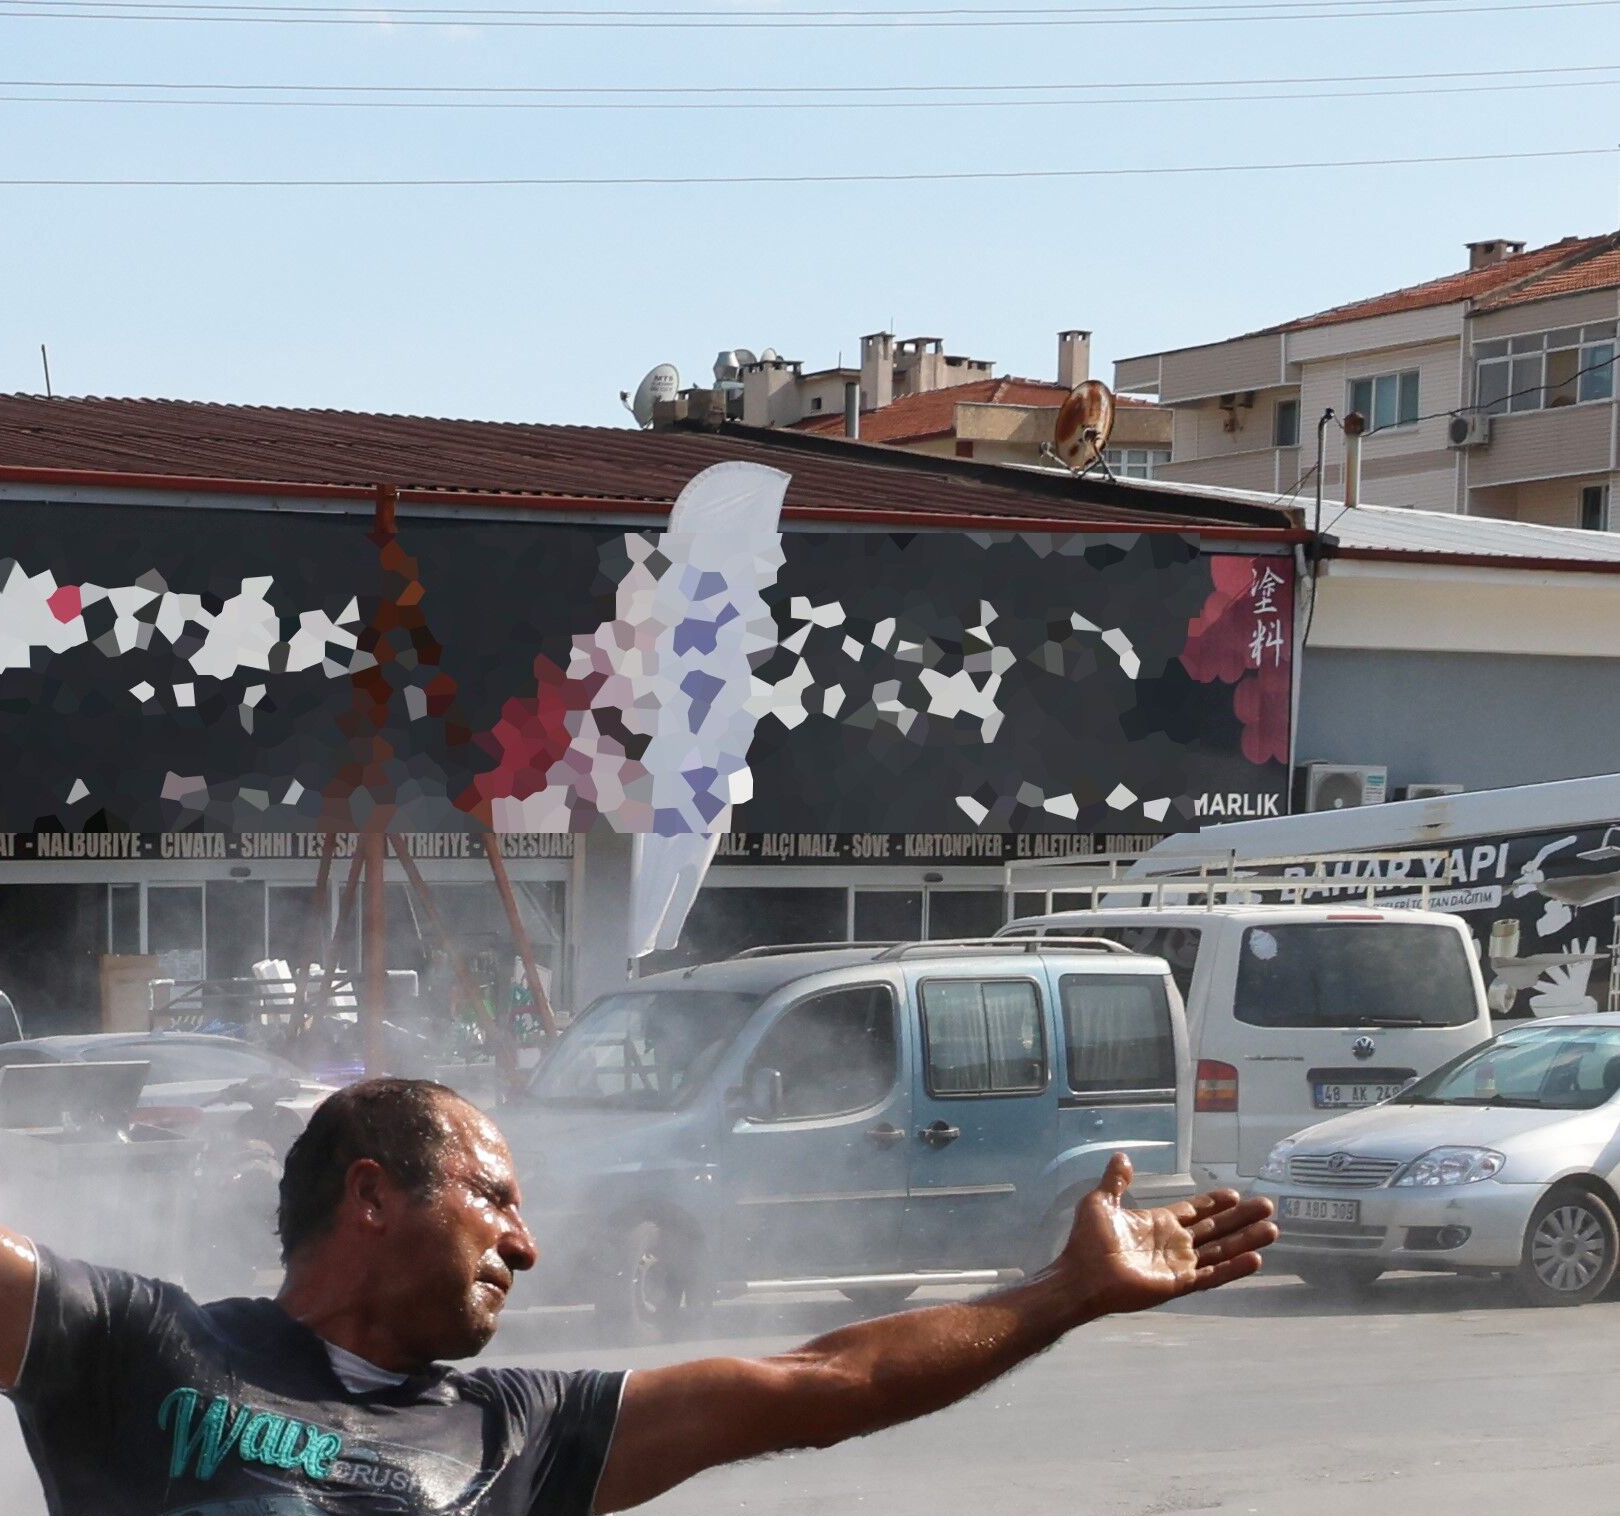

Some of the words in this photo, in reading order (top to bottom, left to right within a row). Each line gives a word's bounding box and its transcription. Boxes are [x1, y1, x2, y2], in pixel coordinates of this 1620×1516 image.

[1248, 566, 1285, 668] 塗料
[1423, 843, 1510, 884] YAPI
[159, 1387, 342, 1481] Wave
